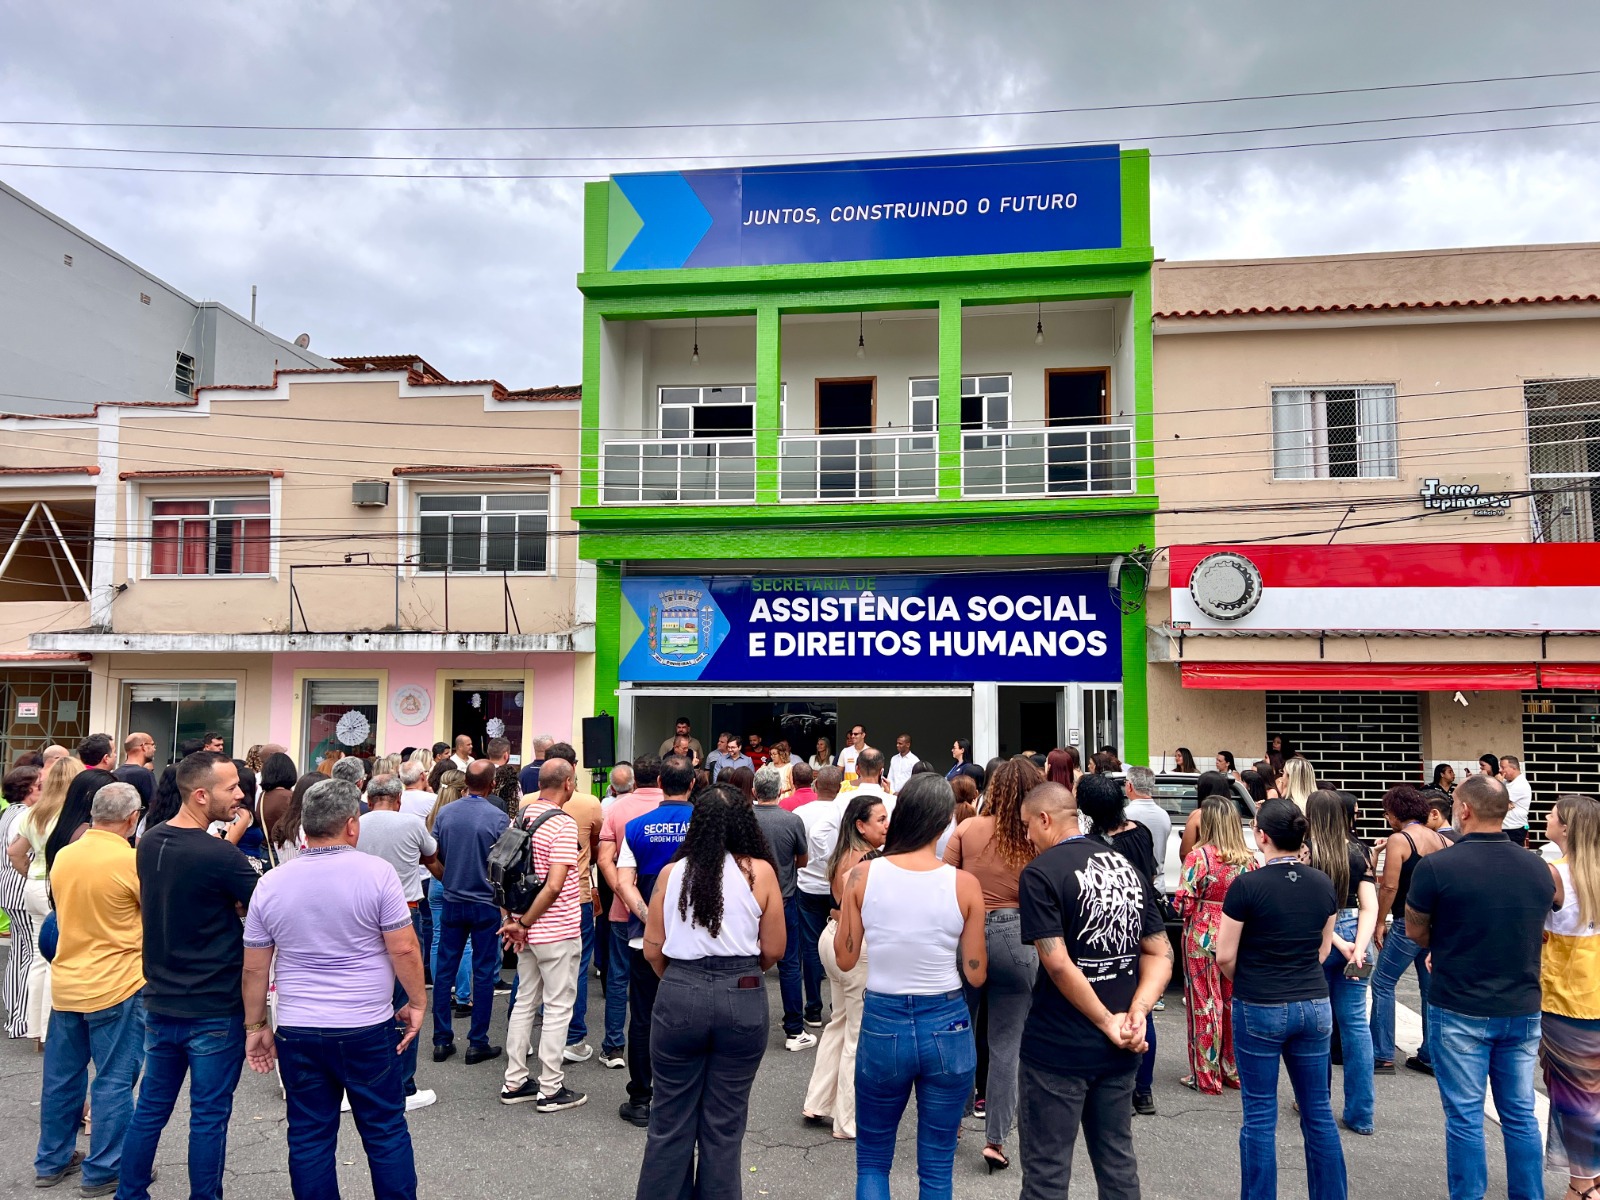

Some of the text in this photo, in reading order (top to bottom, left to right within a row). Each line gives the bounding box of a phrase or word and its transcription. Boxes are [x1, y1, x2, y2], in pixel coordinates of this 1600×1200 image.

[743, 192, 1078, 226] JUNTOS, CONSTRUINDO O FUTURO
[1421, 479, 1479, 496] Torres
[752, 577, 876, 592] SECRETARIA DE
[749, 591, 1097, 622] ASSISTÊNCIA SOCIAL
[749, 630, 1107, 657] E DIREITOS HUMANOS
[1074, 866, 1141, 891] NORTH
[1100, 886, 1144, 911] FACE
